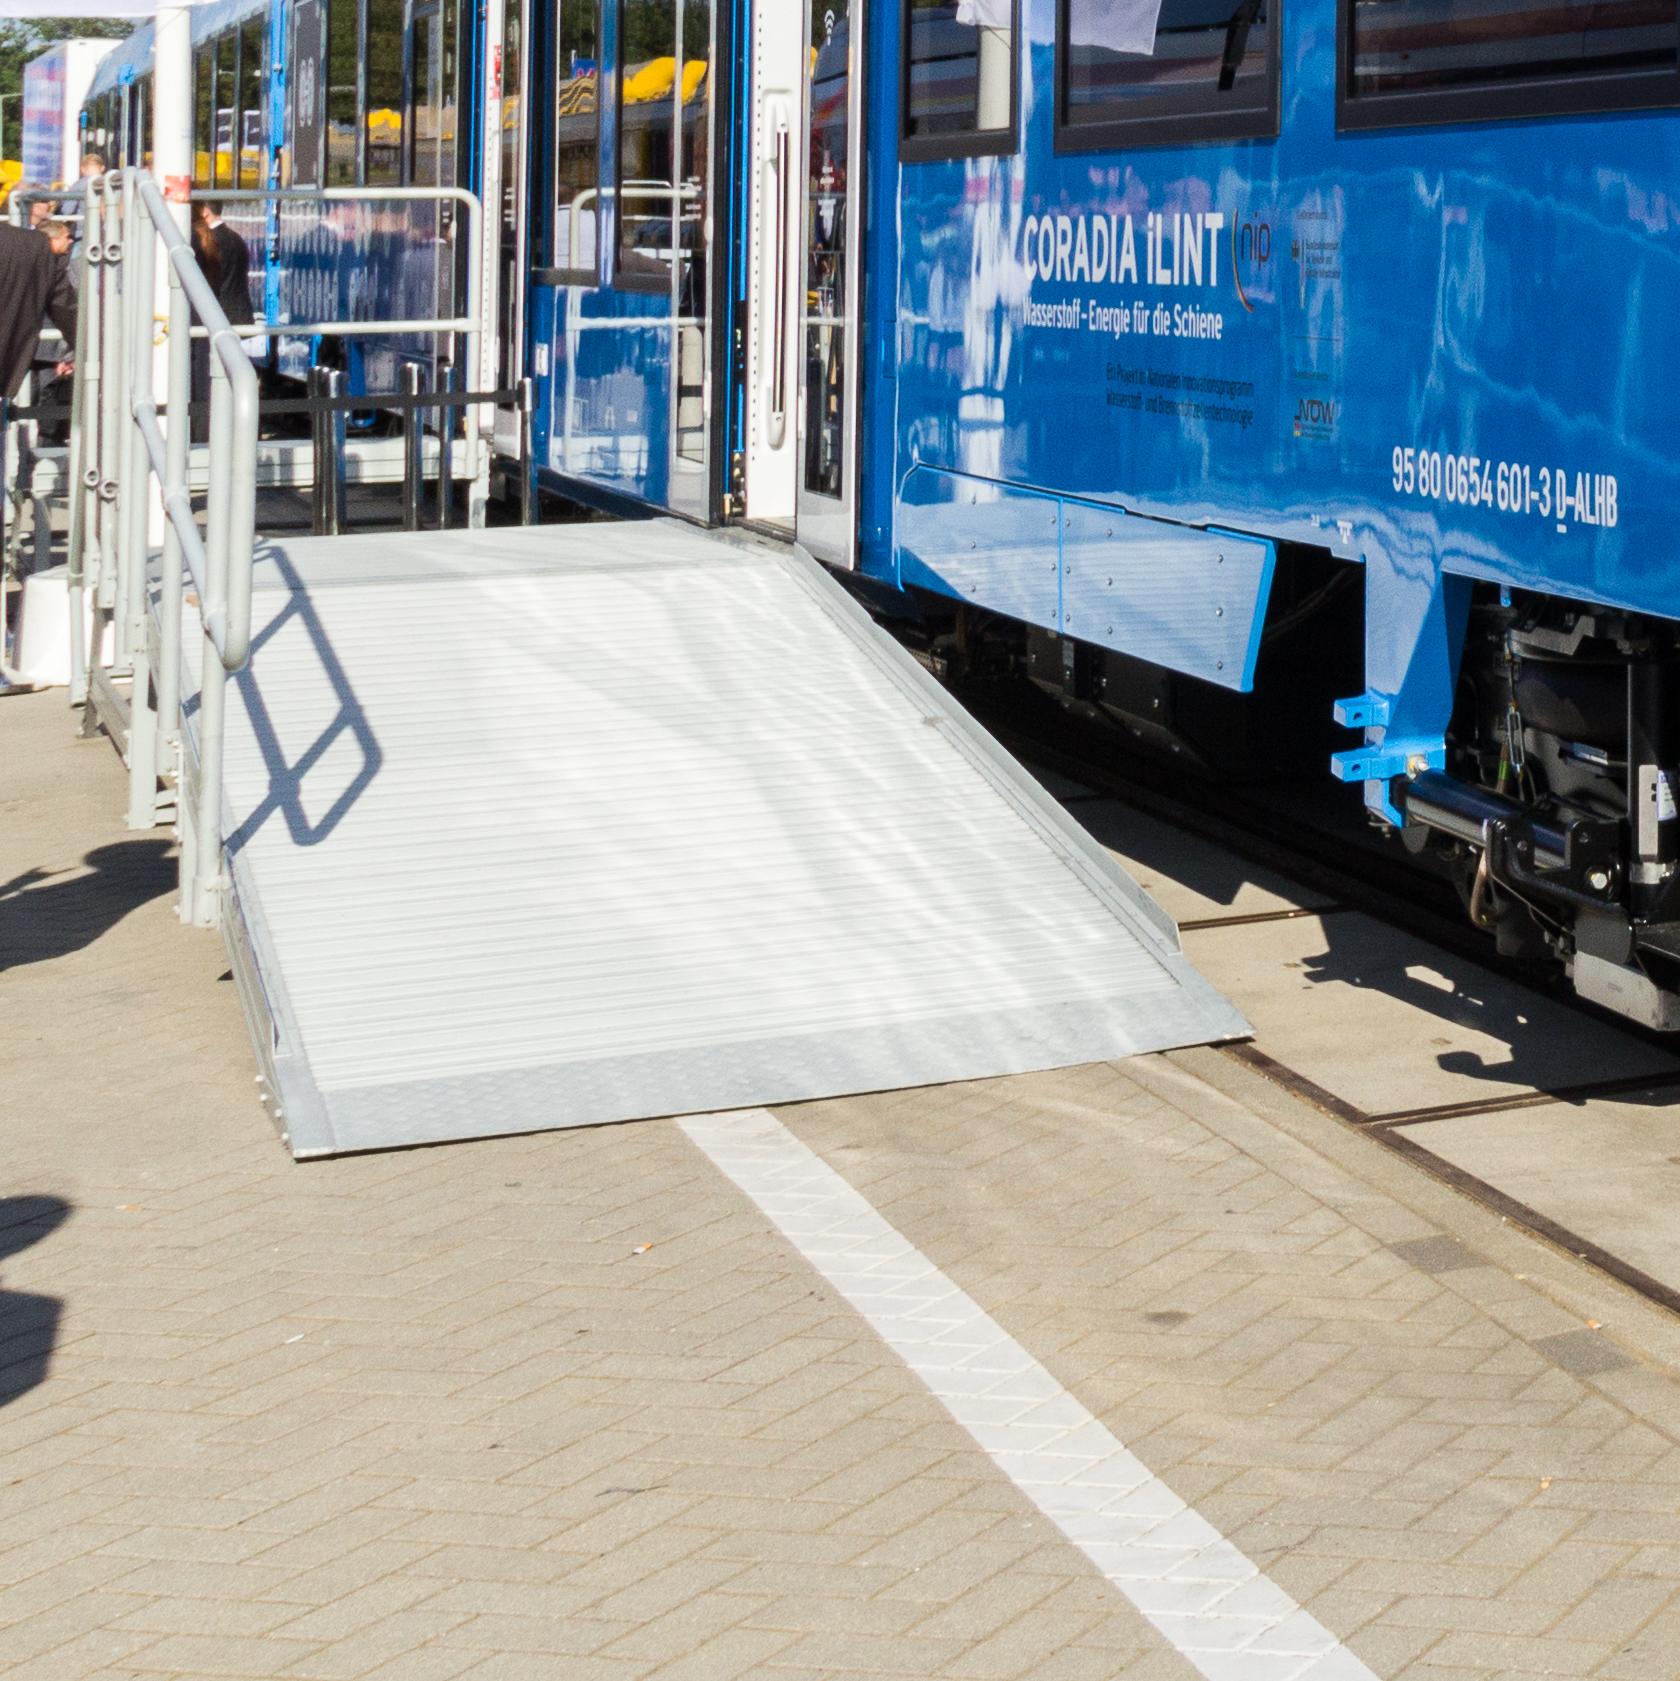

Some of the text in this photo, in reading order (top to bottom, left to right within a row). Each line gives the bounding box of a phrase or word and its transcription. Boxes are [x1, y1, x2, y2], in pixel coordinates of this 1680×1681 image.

[1023, 213, 1138, 284] CORADIA
[1147, 211, 1223, 286] iLINT
[1241, 212, 1271, 271] nip
[1133, 301, 1150, 335] für
[1153, 302, 1170, 336] die
[1173, 303, 1223, 339] Schiene
[1392, 446, 1618, 532] 95 80 0654 601-3 D-ALHB
